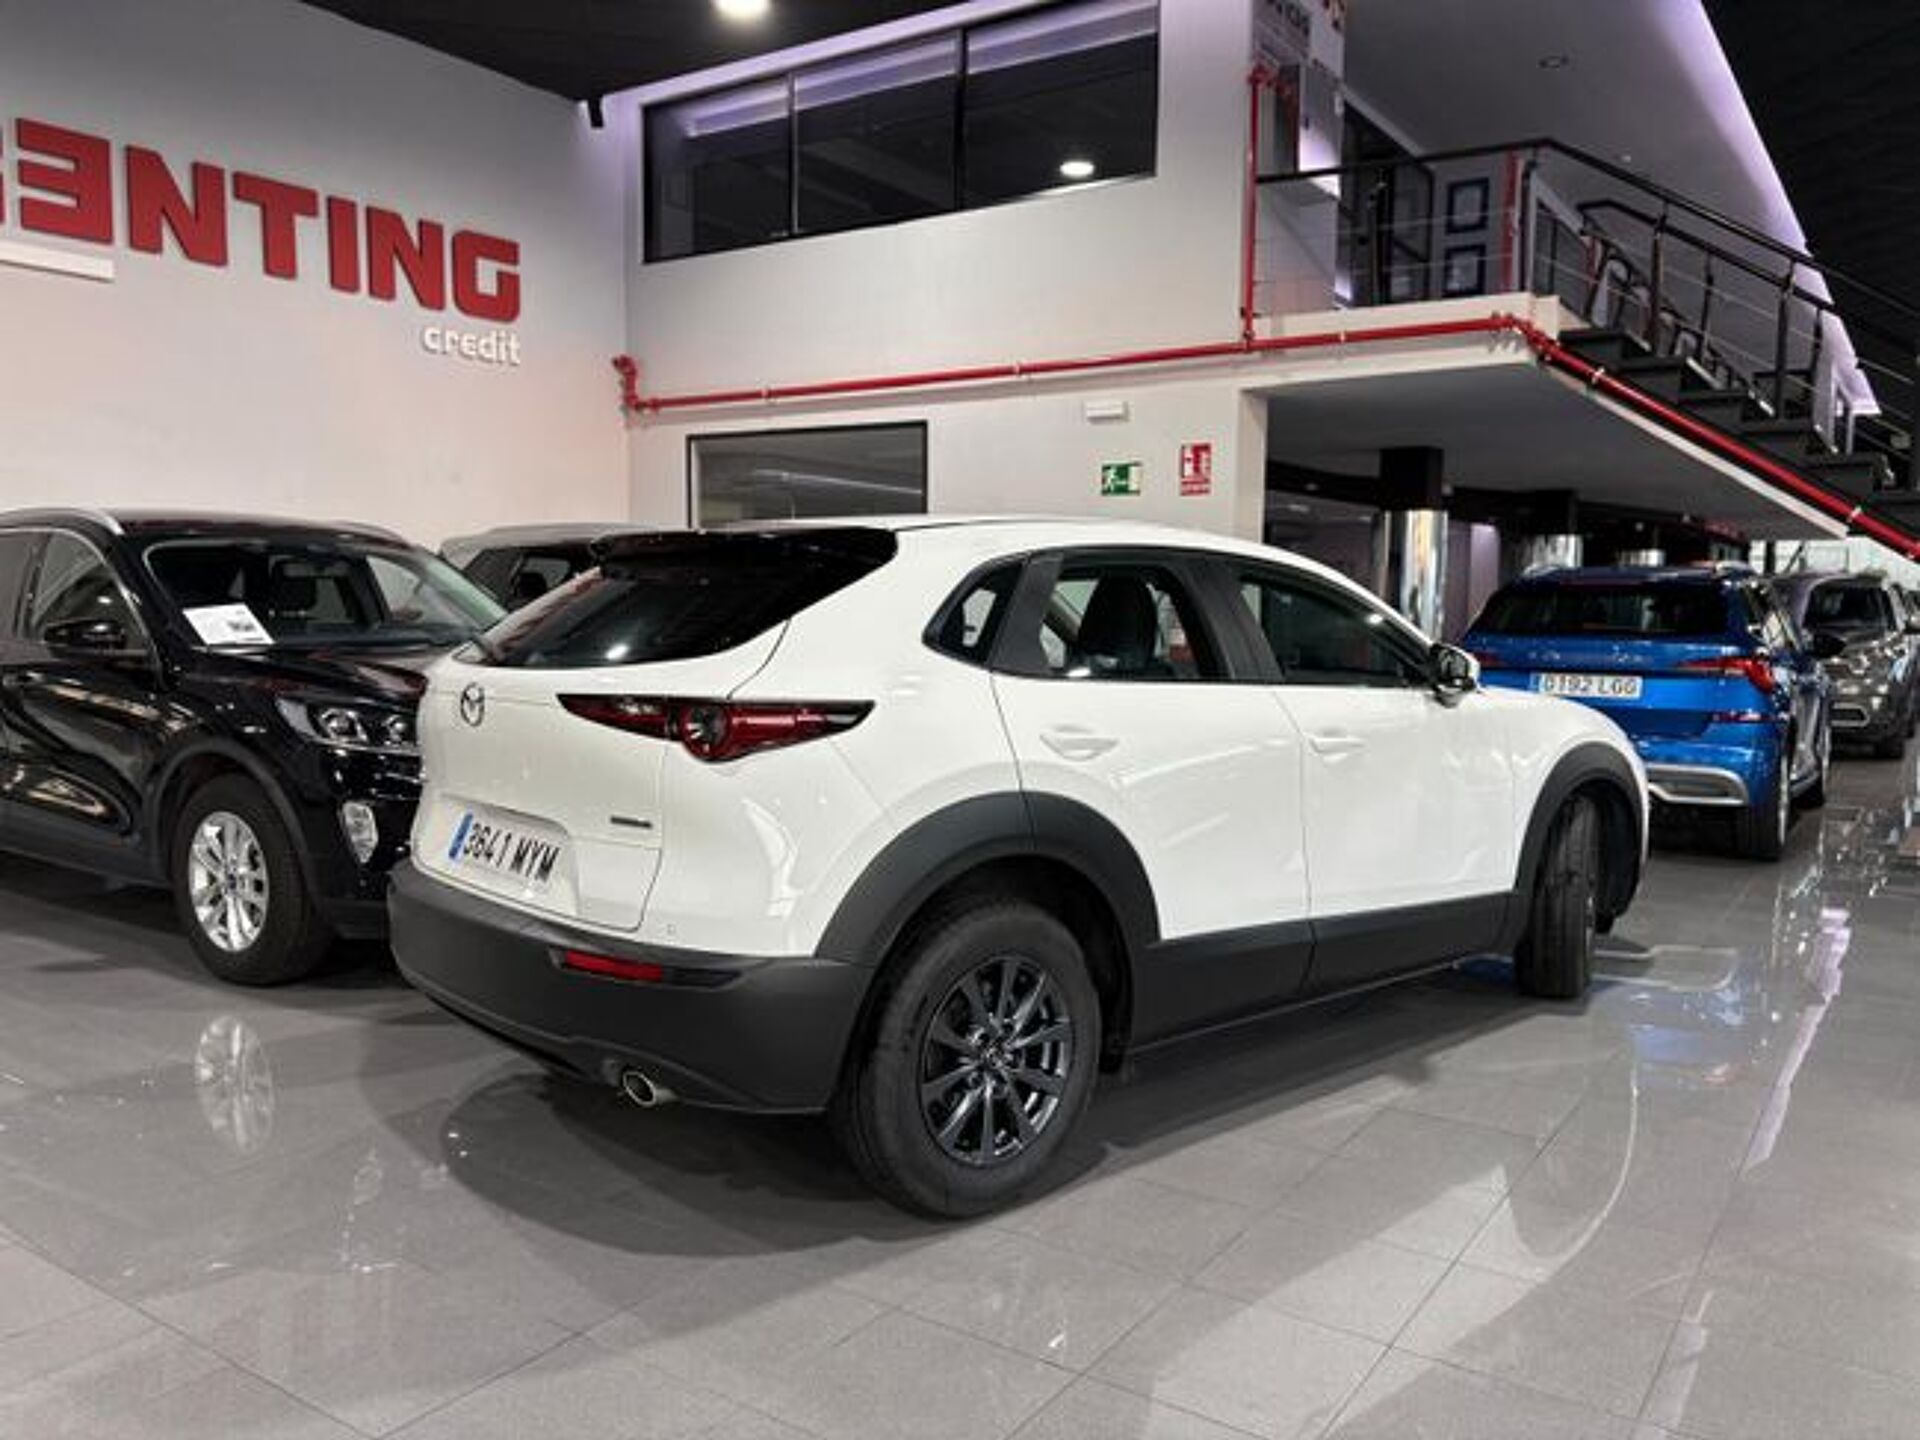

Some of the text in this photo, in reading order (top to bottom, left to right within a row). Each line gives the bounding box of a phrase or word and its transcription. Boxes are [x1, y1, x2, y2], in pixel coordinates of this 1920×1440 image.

[0, 118, 520, 323] ENTING
[422, 326, 520, 365] credit
[464, 822, 512, 867] 3641
